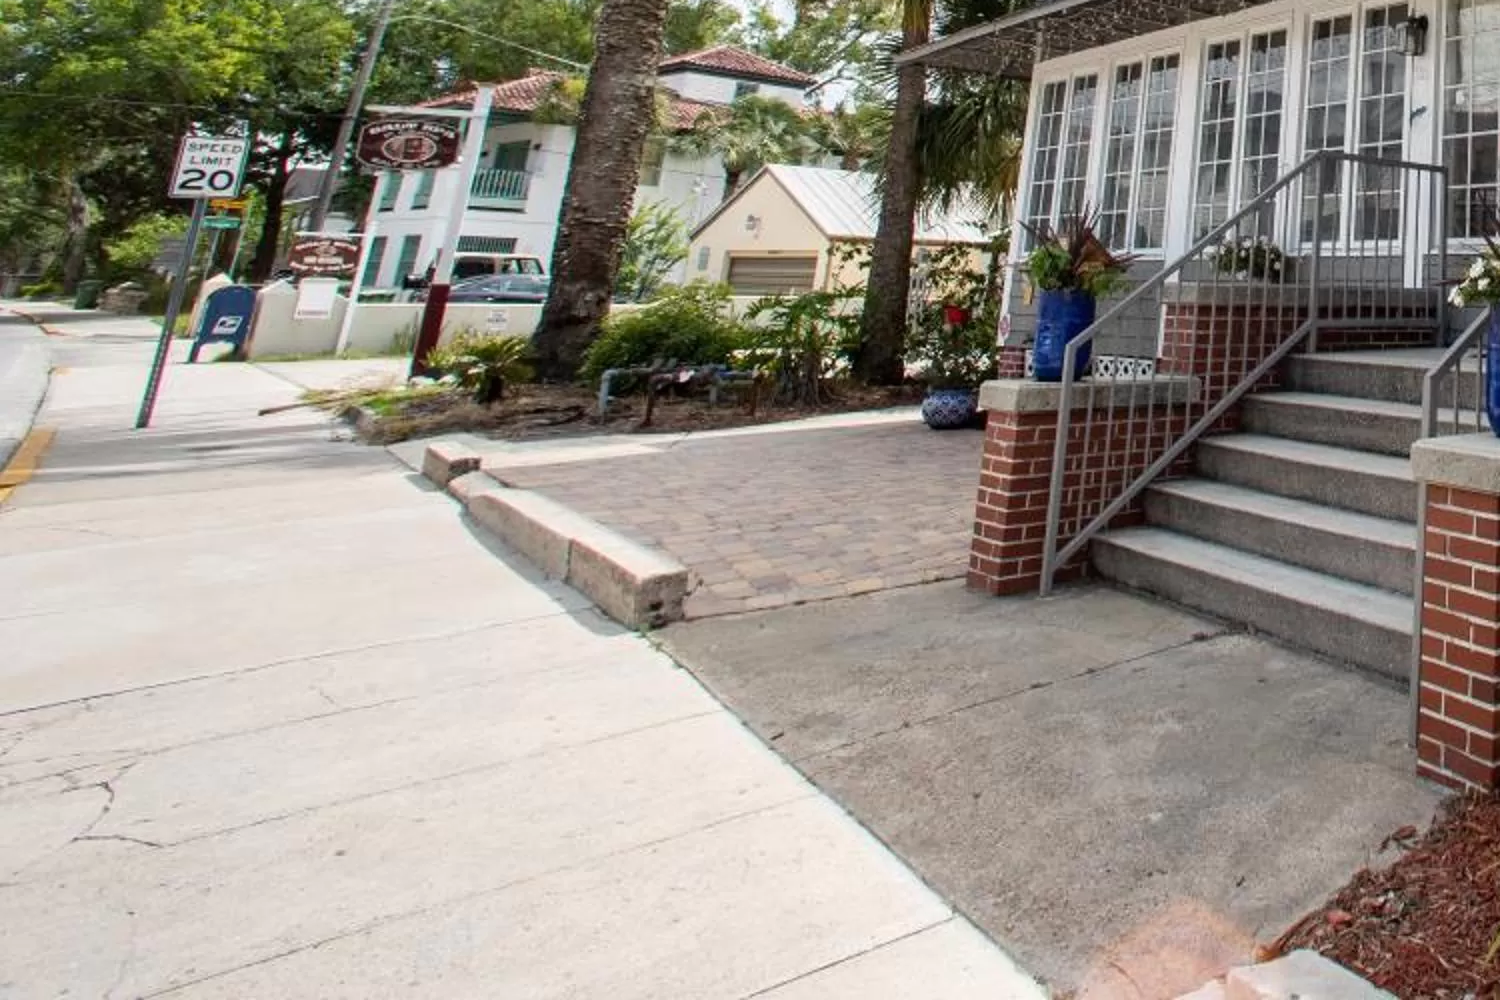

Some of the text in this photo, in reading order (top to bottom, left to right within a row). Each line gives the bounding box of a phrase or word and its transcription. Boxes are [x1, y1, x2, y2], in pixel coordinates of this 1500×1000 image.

[188, 143, 243, 154] SPEED
[190, 156, 234, 165] LIMIT
[178, 169, 235, 191] 20
